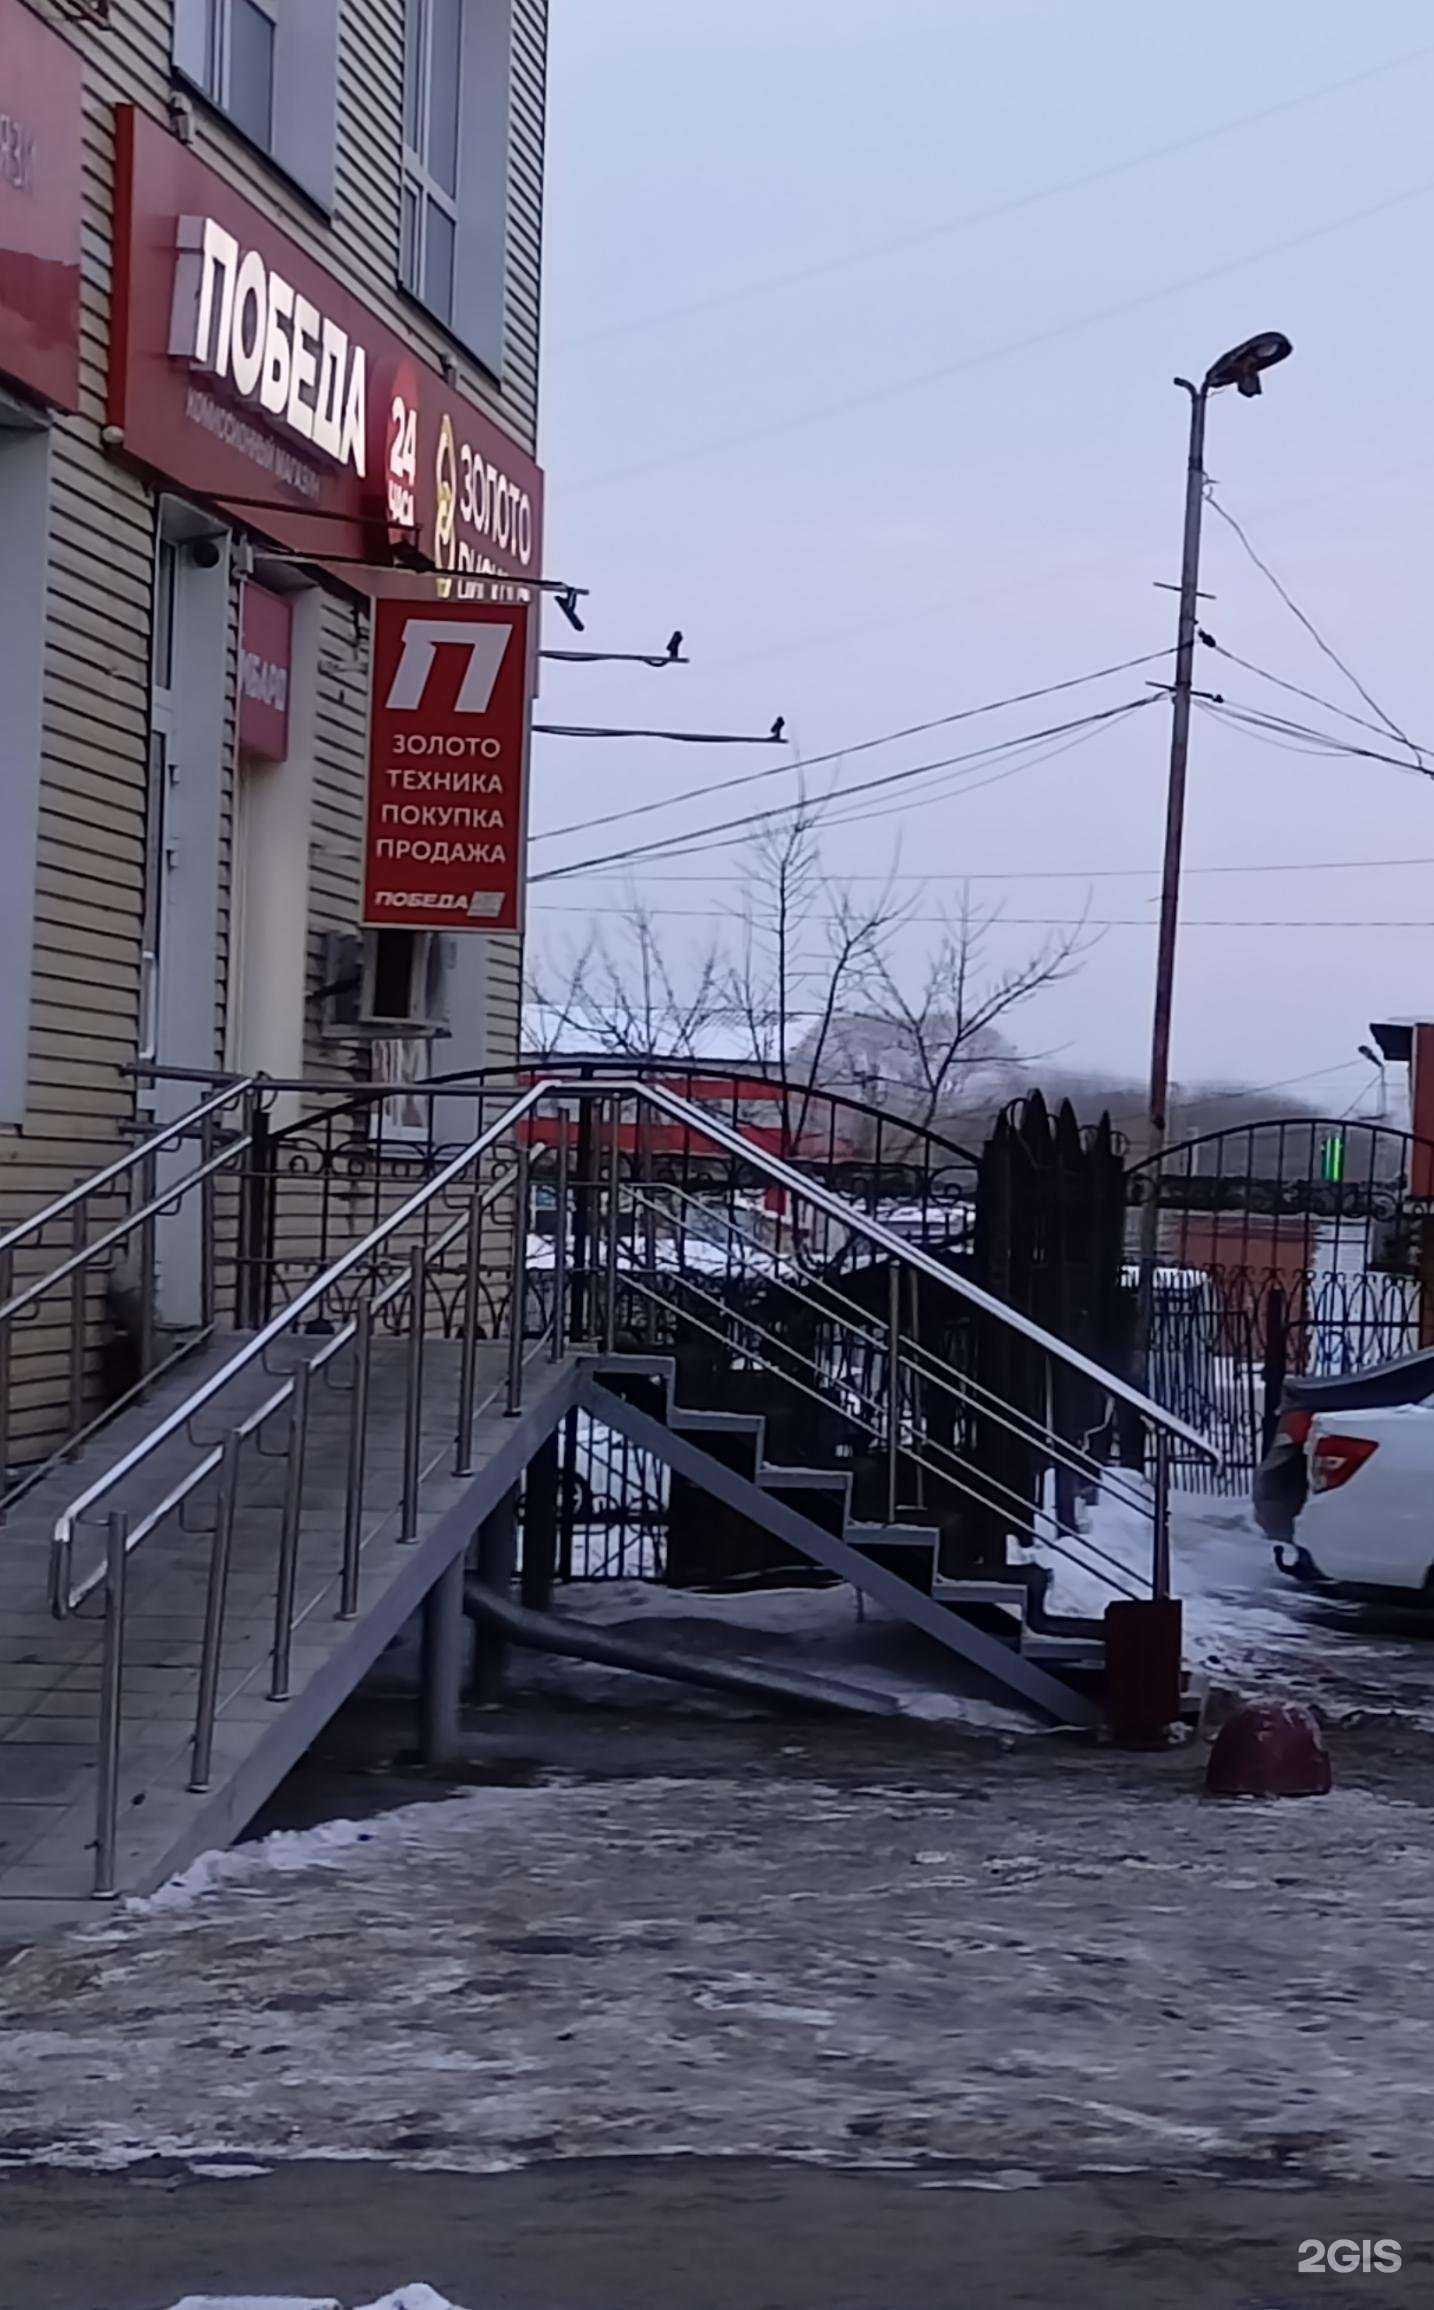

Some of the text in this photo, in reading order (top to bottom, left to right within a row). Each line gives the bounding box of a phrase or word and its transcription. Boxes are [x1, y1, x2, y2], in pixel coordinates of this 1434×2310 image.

[195, 217, 367, 479] ПОБЕДА
[389, 396, 417, 487] 24
[459, 443, 532, 566] ЗОЛОТО
[385, 618, 514, 714] П
[392, 733, 501, 759] ЗОЛОТО
[386, 768, 504, 795] ТЕХНИКА
[380, 804, 505, 829] ПОКУПКА
[375, 838, 507, 865] ПРОДАЖА
[374, 891, 470, 911] ПОБЕДА
